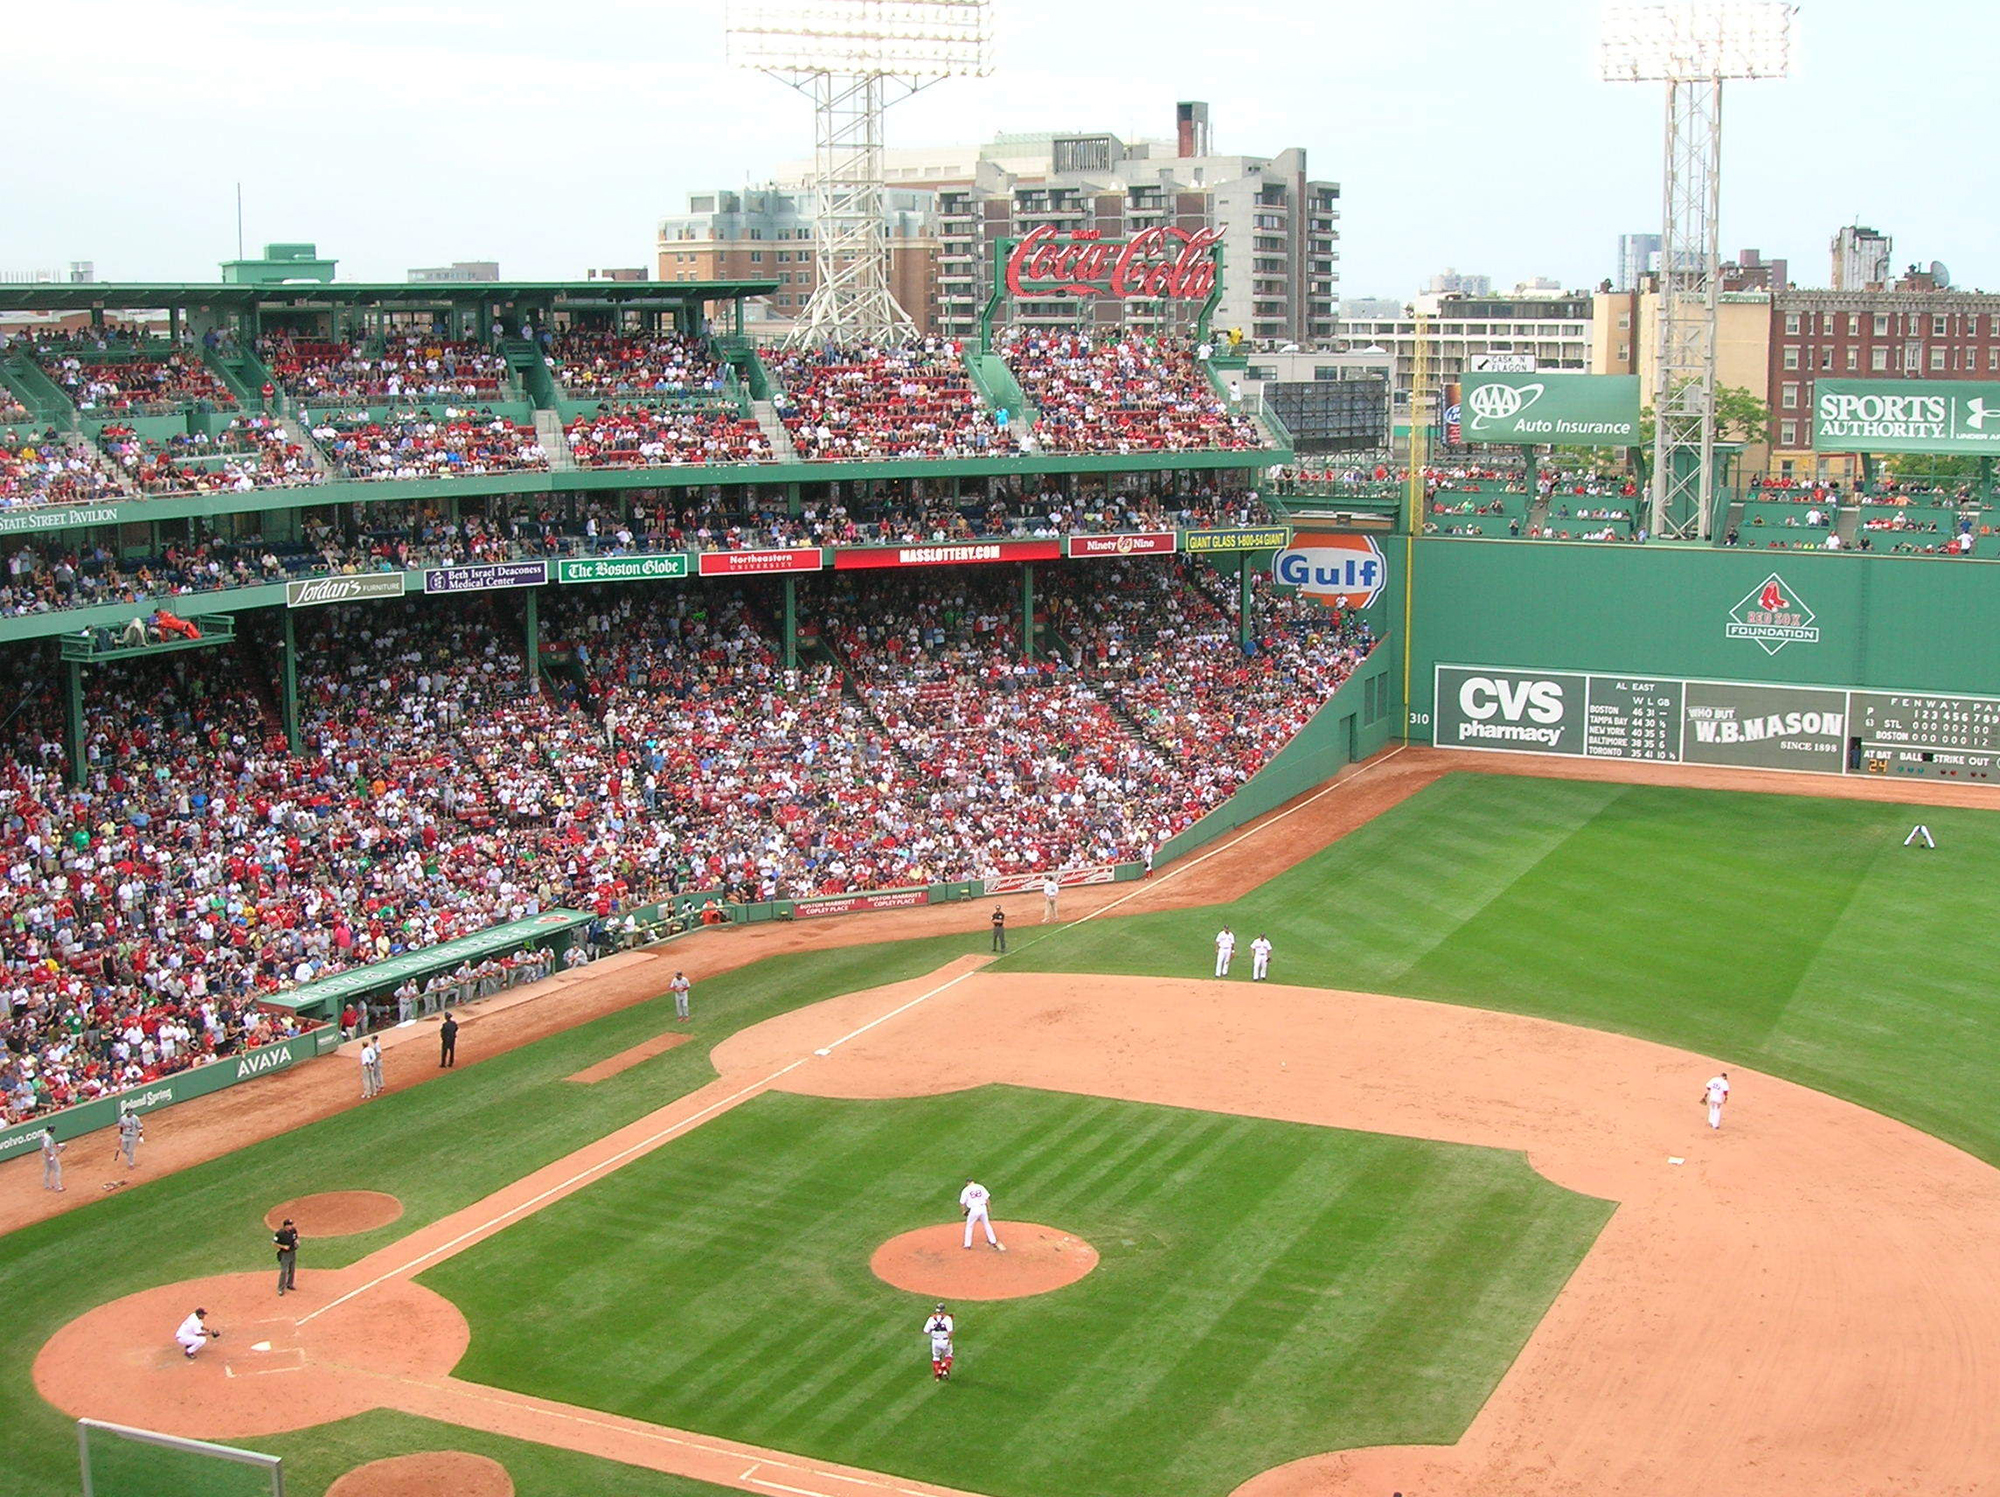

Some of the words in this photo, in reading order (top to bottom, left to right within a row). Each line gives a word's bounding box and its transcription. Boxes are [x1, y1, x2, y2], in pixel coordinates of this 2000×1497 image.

[1005, 225, 1227, 297] Coca-Cola
[1491, 364, 1527, 372] FLAGON
[1475, 384, 1515, 417] AAA
[1820, 394, 1946, 422] SPORTS
[1513, 418, 1552, 432] Auto
[1555, 418, 1631, 434] Insurance
[1820, 421, 1944, 438] AUTHORITY
[0, 517, 28, 531] STATE
[28, 514, 67, 528] STREET
[68, 508, 118, 524] PAVILION
[1086, 540, 1116, 551] Ninety
[1133, 538, 1155, 548] Nine
[1190, 536, 1211, 549] GIANT
[1212, 534, 1236, 548] GLASS
[1264, 532, 1284, 545] GIANT
[730, 554, 793, 564] Northeastern
[900, 545, 1001, 564] MASSLOTTERY.COM
[448, 570, 469, 581] Beth
[471, 567, 496, 578] Israel
[498, 565, 542, 577] Deaconess
[568, 563, 593, 578] The
[594, 562, 640, 576] Boston
[642, 559, 678, 574] Globe
[730, 562, 793, 570] UNIVERSITY
[1280, 554, 1378, 586] Gulf
[448, 577, 484, 590] Medical
[486, 576, 516, 586] Center
[295, 579, 362, 604] Jordan's
[362, 583, 400, 592] FURNITURE
[1747, 610, 1773, 625] RED
[1774, 612, 1801, 627] SOX
[1731, 626, 1814, 639] FOUNDATION
[1616, 682, 1628, 690] AL
[1632, 682, 1656, 692] EAST
[1459, 676, 1564, 724] CVS
[1632, 696, 1644, 705] W
[1647, 698, 1654, 706] L
[1657, 698, 1670, 706] GB
[1589, 705, 1620, 714] BOSTON
[1632, 708, 1644, 716] 46
[1646, 708, 1655, 717] 31
[1688, 708, 1712, 720] WHO
[1714, 709, 1735, 720] BUT
[1410, 712, 1429, 725] 310
[1590, 715, 1612, 725] TAMPA
[1614, 716, 1628, 726] BAY
[1632, 718, 1643, 727] 44
[1644, 719, 1656, 728] 30
[1884, 719, 1902, 729] STL
[1458, 721, 1562, 746] pharmacy
[1588, 726, 1606, 734] NEW
[1607, 726, 1626, 736] YORK
[1632, 728, 1642, 737] 40
[1644, 730, 1655, 738] 35
[1659, 730, 1666, 738] 5
[1876, 730, 1909, 741] BOSTON
[1588, 736, 1628, 747] BALTIMORE
[1644, 740, 1655, 748] 35
[1658, 740, 1666, 749] 6
[1780, 741, 1812, 752] SINCE
[1814, 743, 1838, 753] 1898
[1588, 746, 1622, 756] TORONTO
[1630, 749, 1642, 758] 35
[1644, 750, 1654, 759] 41
[1657, 752, 1666, 760] 10
[1864, 750, 1876, 760] AT
[1876, 750, 1892, 760] BAT
[1900, 752, 1923, 762] BALL
[1932, 754, 1965, 766] STRIKE
[1968, 756, 1990, 767] OUT
[1868, 758, 1888, 773] 24
[800, 902, 824, 910] BOSTON
[824, 898, 856, 908] MARRIOTT
[867, 894, 892, 903] BOSTON
[892, 892, 922, 900] MARRIOTT
[874, 900, 898, 908] COPLEY
[898, 898, 916, 906] PLACE
[806, 906, 830, 915] COPLEY
[830, 904, 849, 912] PLACE
[236, 1046, 292, 1078] AVAYA
[120, 1093, 146, 1114] Poland
[147, 1088, 172, 1106] Spring
